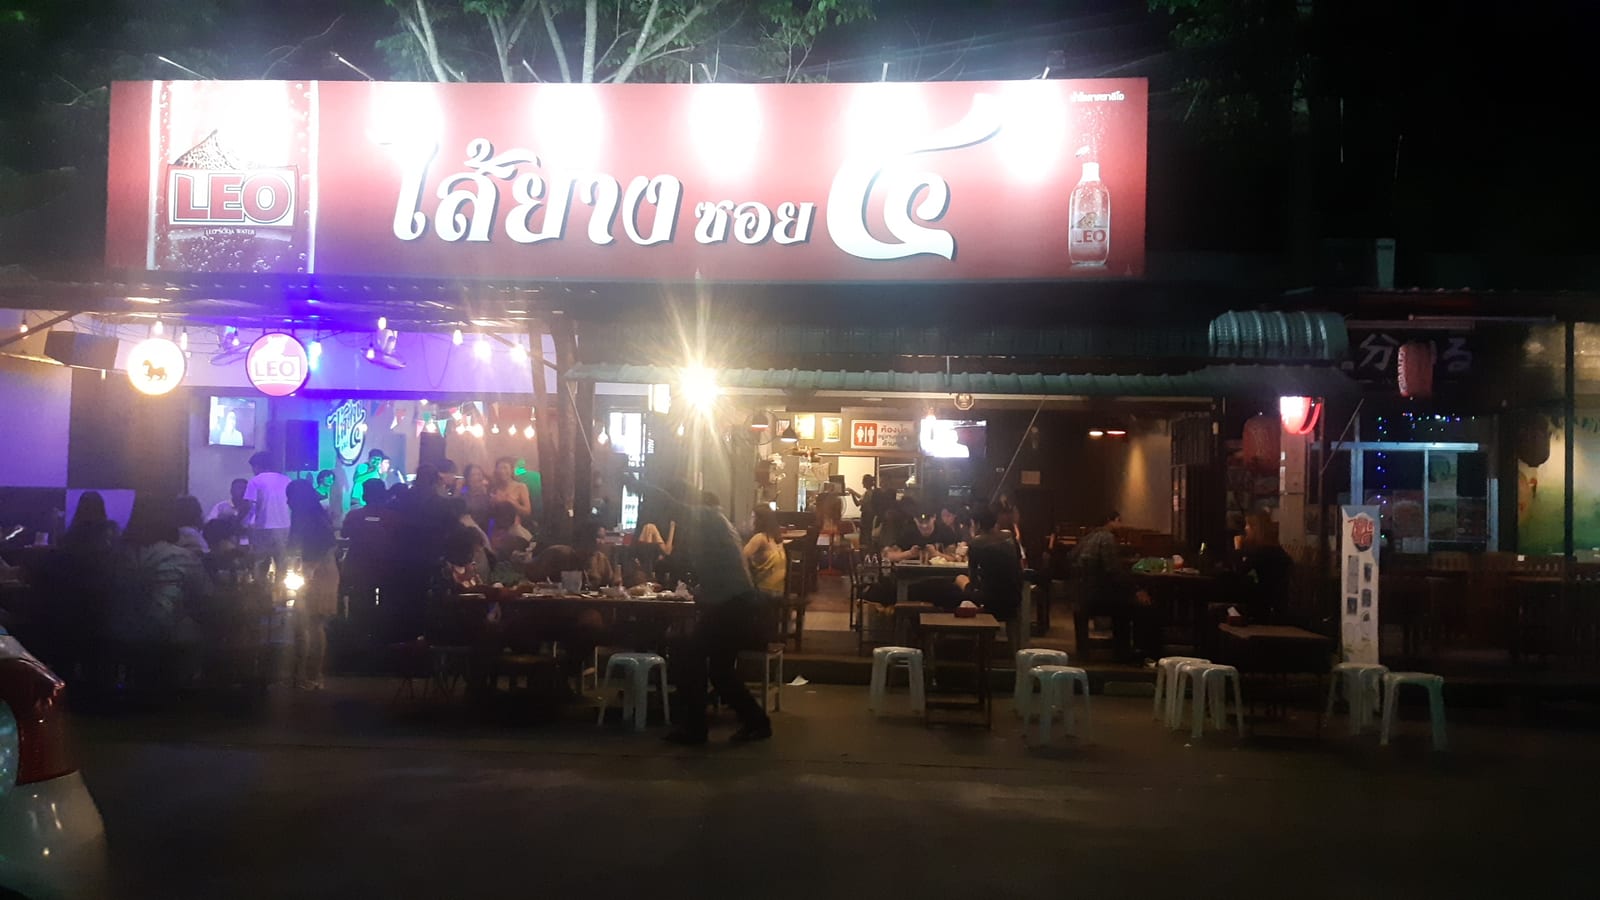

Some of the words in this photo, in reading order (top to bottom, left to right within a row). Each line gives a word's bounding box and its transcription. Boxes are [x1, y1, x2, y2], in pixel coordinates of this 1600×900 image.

[174, 173, 292, 224] LEO
[694, 199, 818, 245] ซอย
[254, 360, 296, 377] LEO
[1359, 333, 1473, 373] 分る
